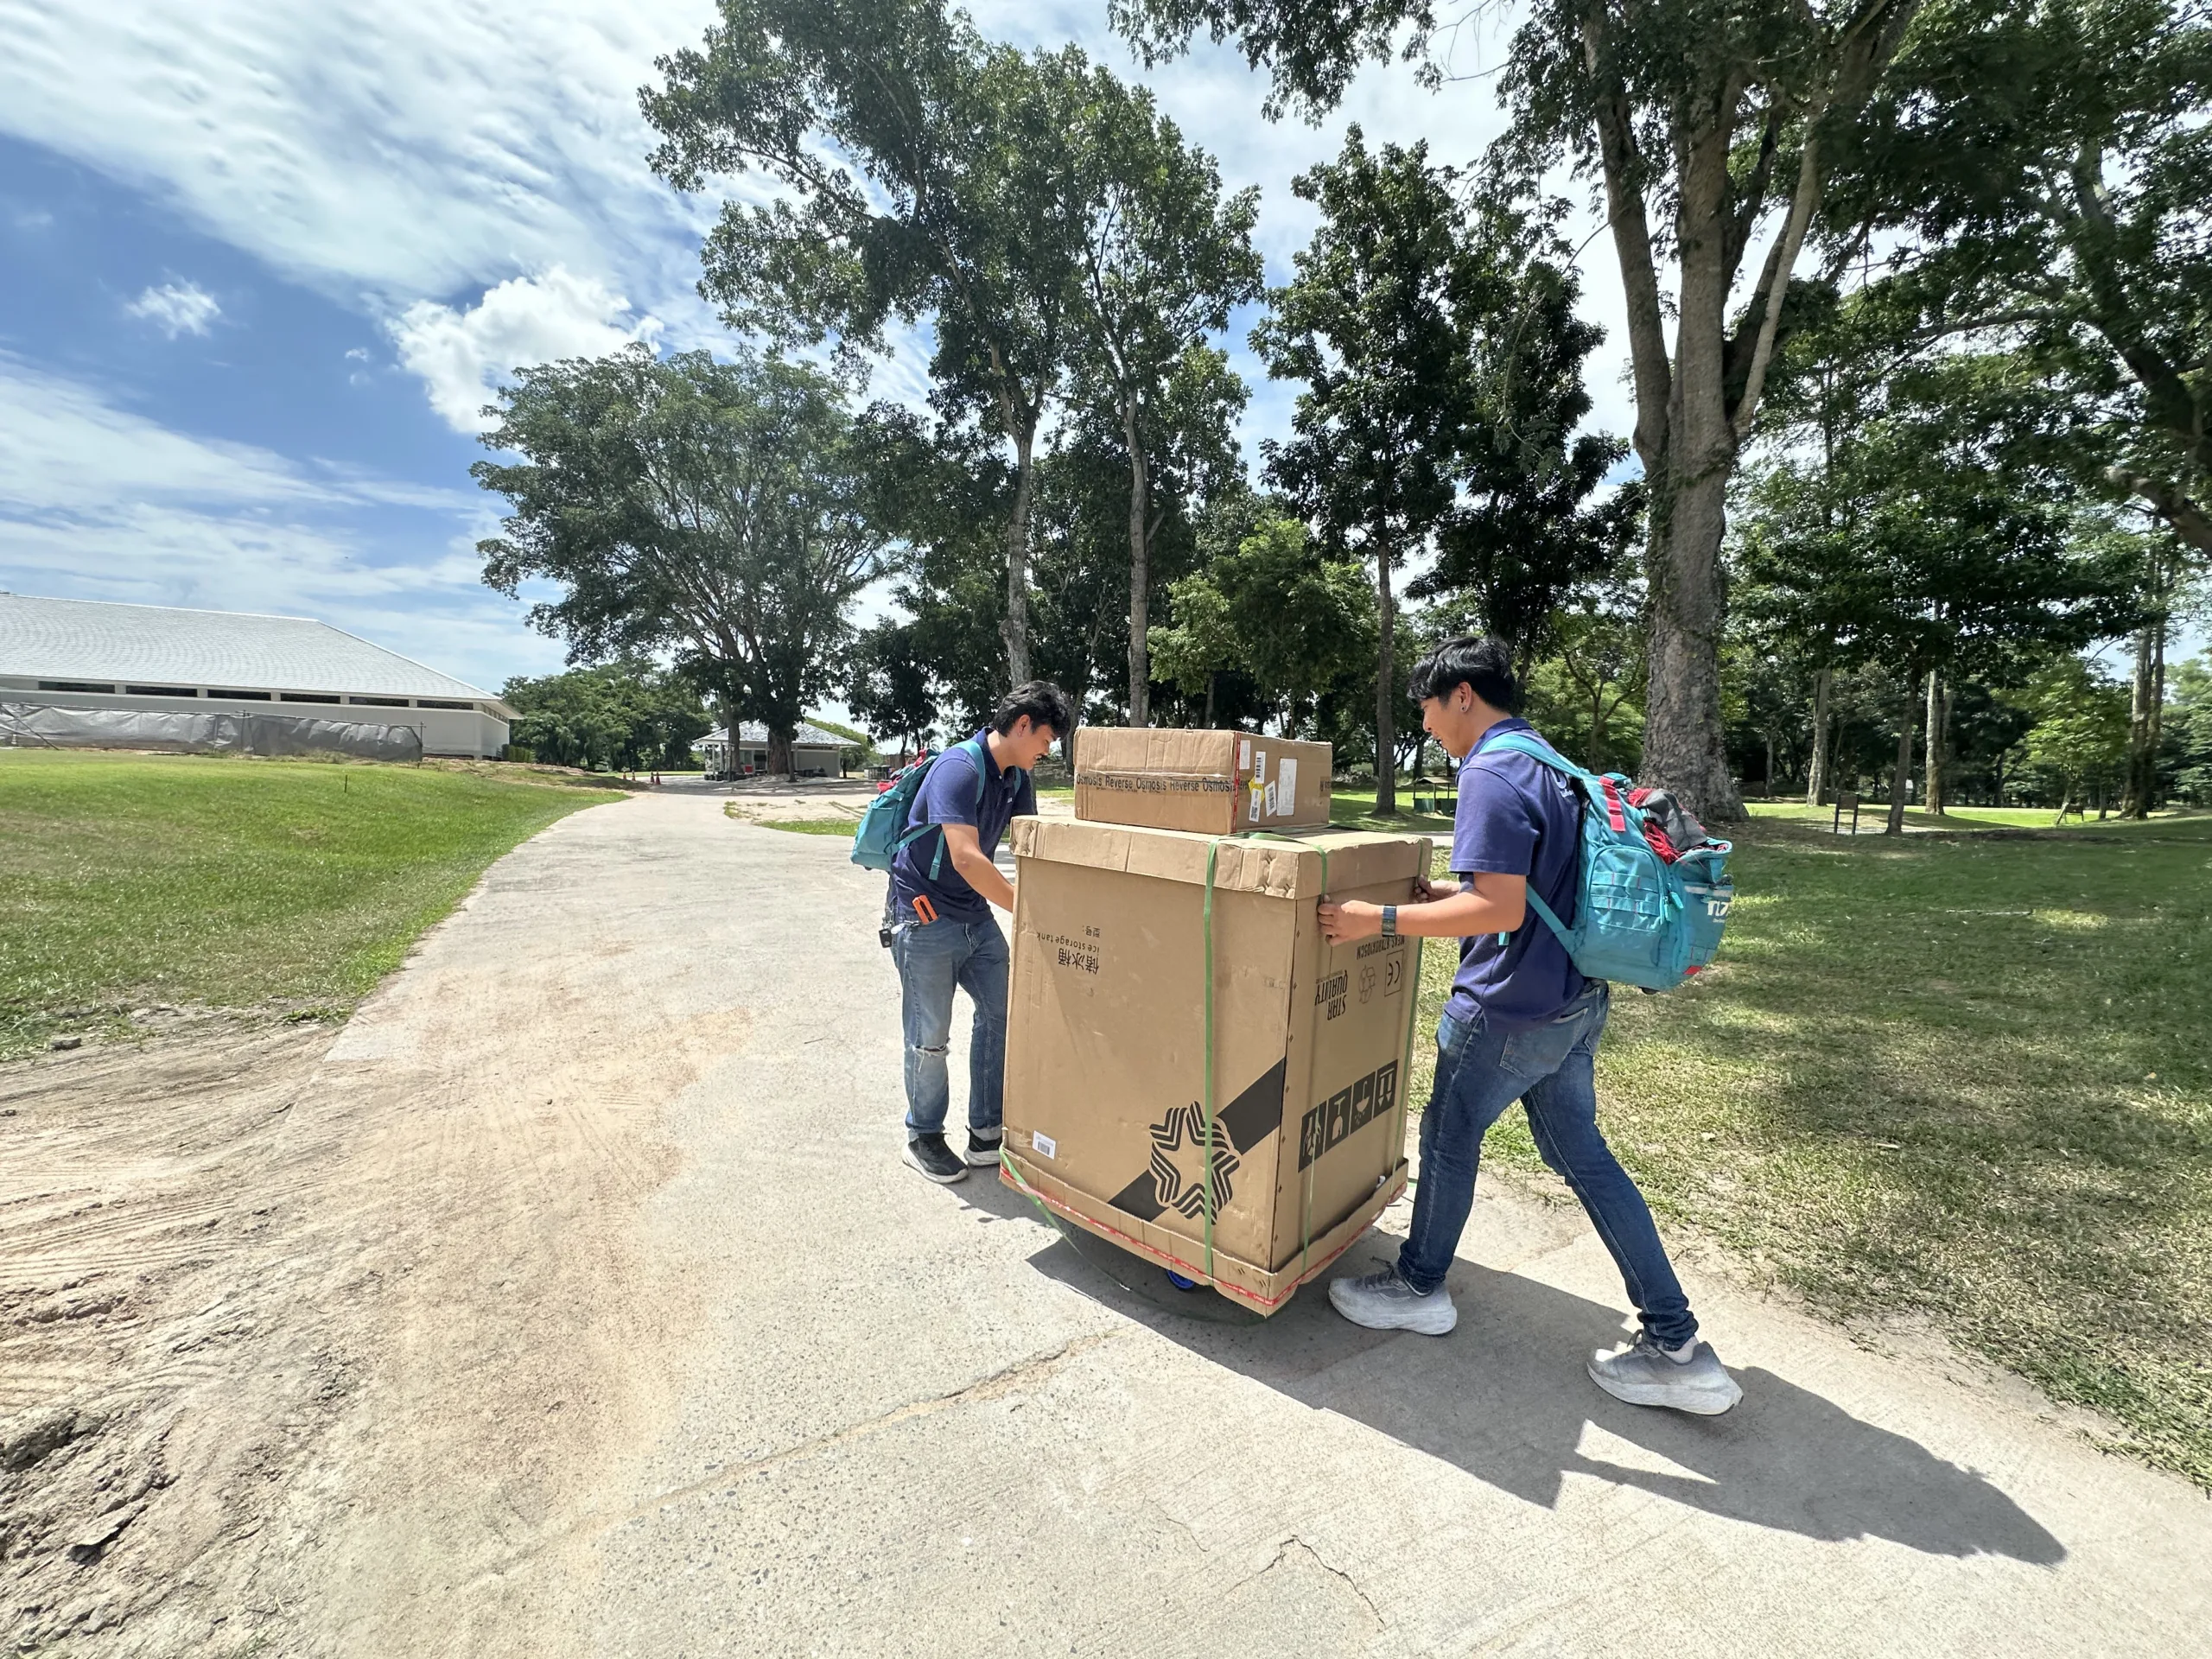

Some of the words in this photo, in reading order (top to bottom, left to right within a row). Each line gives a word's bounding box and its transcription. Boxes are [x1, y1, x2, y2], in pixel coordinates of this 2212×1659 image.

[1076, 773, 1103, 786] Osmosis
[1105, 775, 1134, 789] Reverse
[1136, 777, 1167, 791] Osmosis
[1037, 931, 1053, 944] tank
[1055, 936, 1085, 950] storage
[1088, 944, 1099, 956] ice
[1058, 948, 1099, 975] 储冰桶
[1314, 969, 1348, 1006] QUALITY
[1327, 995, 1347, 1020] STAR
